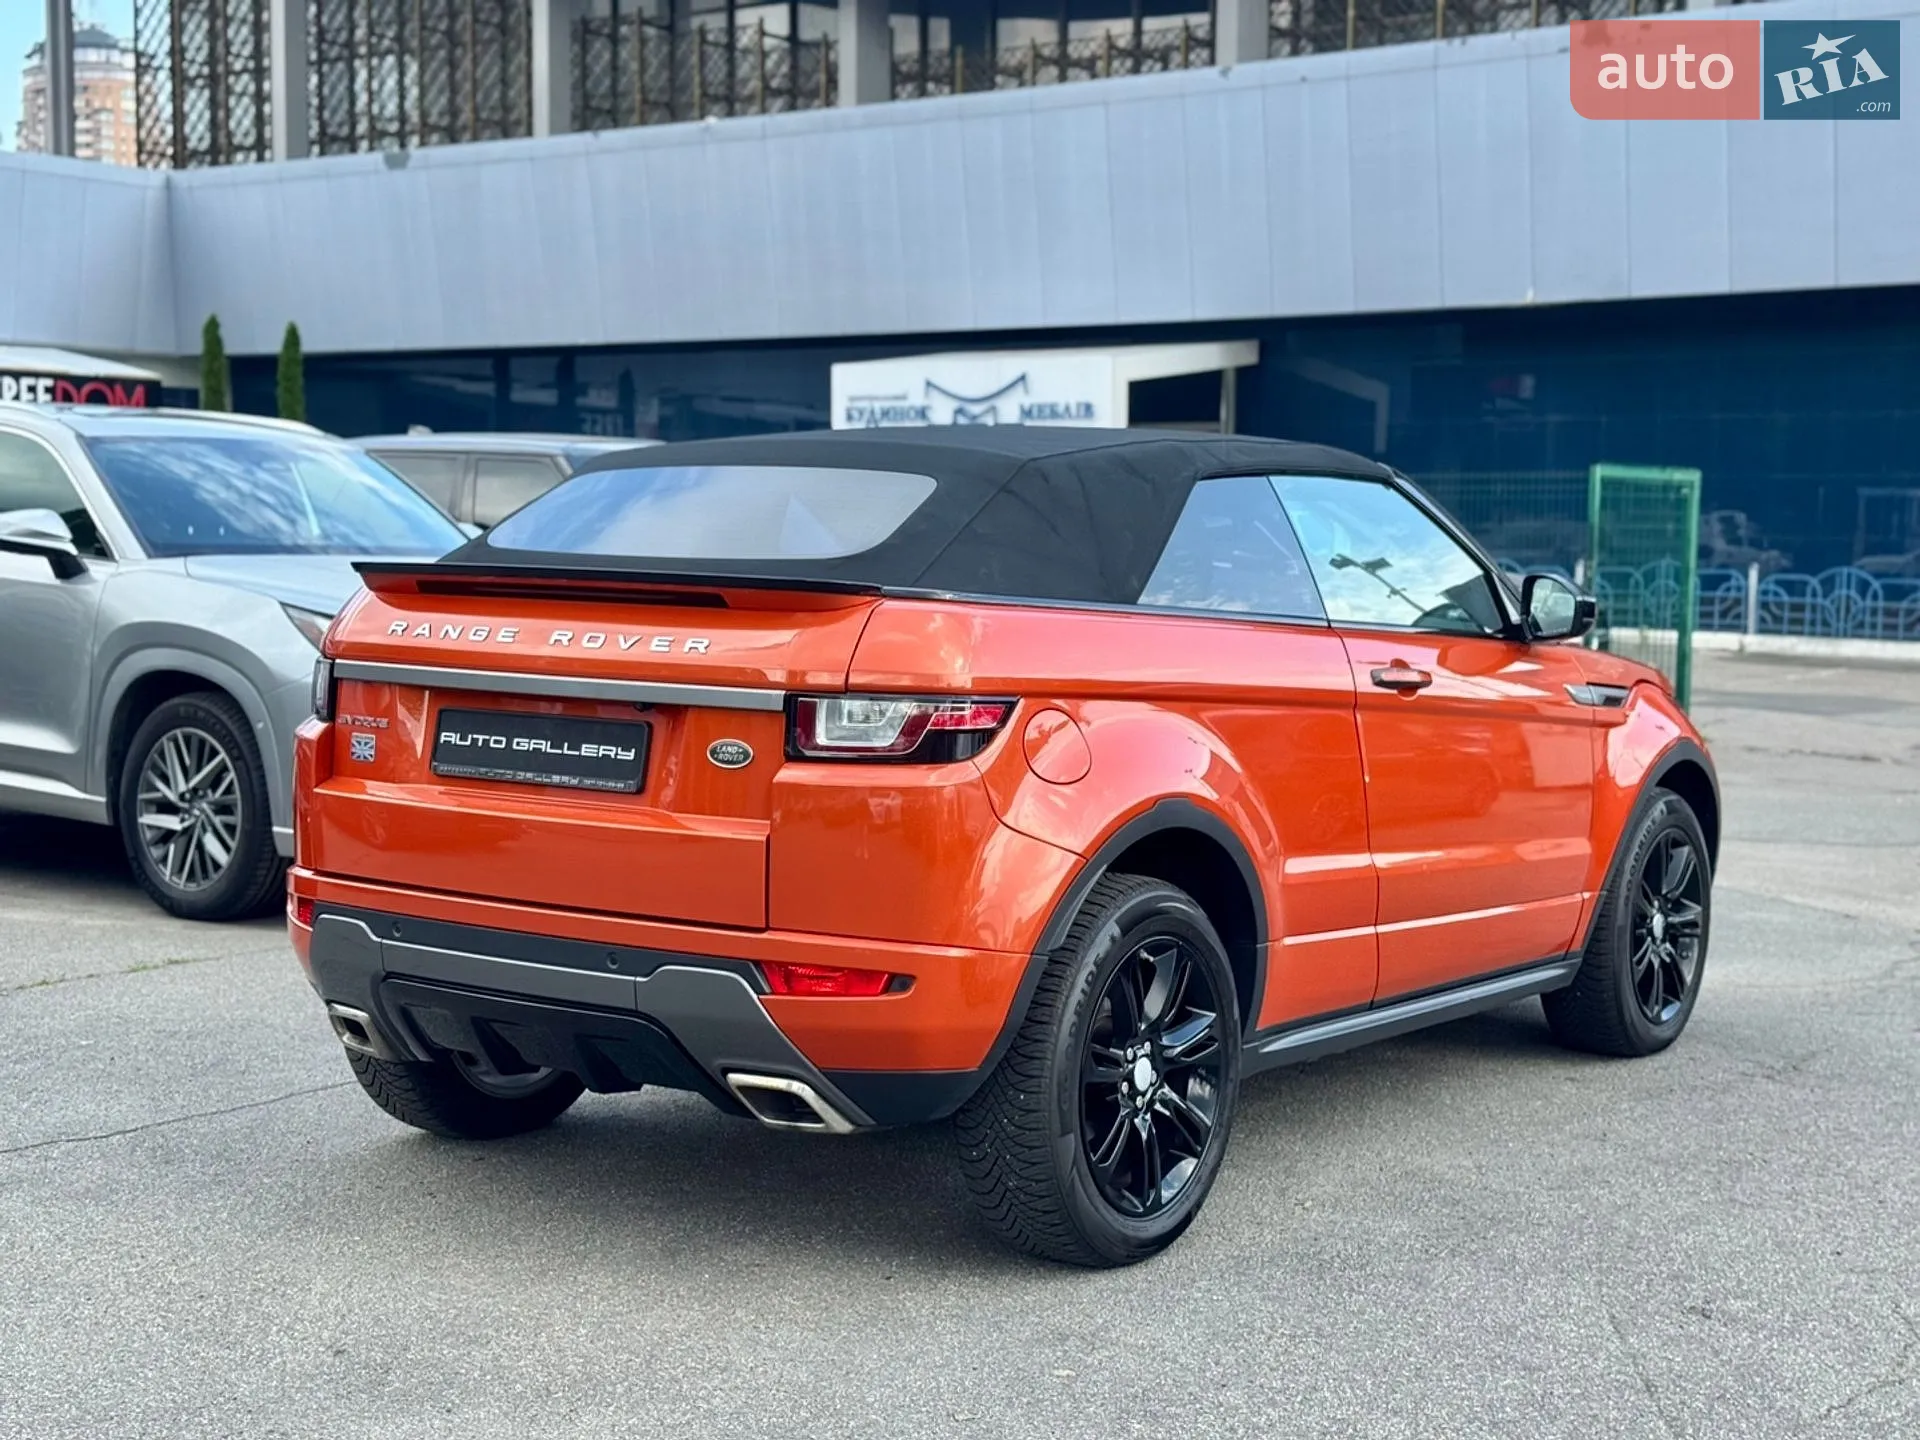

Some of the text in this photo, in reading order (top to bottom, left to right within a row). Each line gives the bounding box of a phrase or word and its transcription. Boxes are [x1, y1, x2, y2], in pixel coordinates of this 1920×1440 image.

[0, 376, 146, 408] REEDOM
[387, 620, 711, 654] RANGE ROVER
[440, 731, 635, 761] AUTO GALLERY
